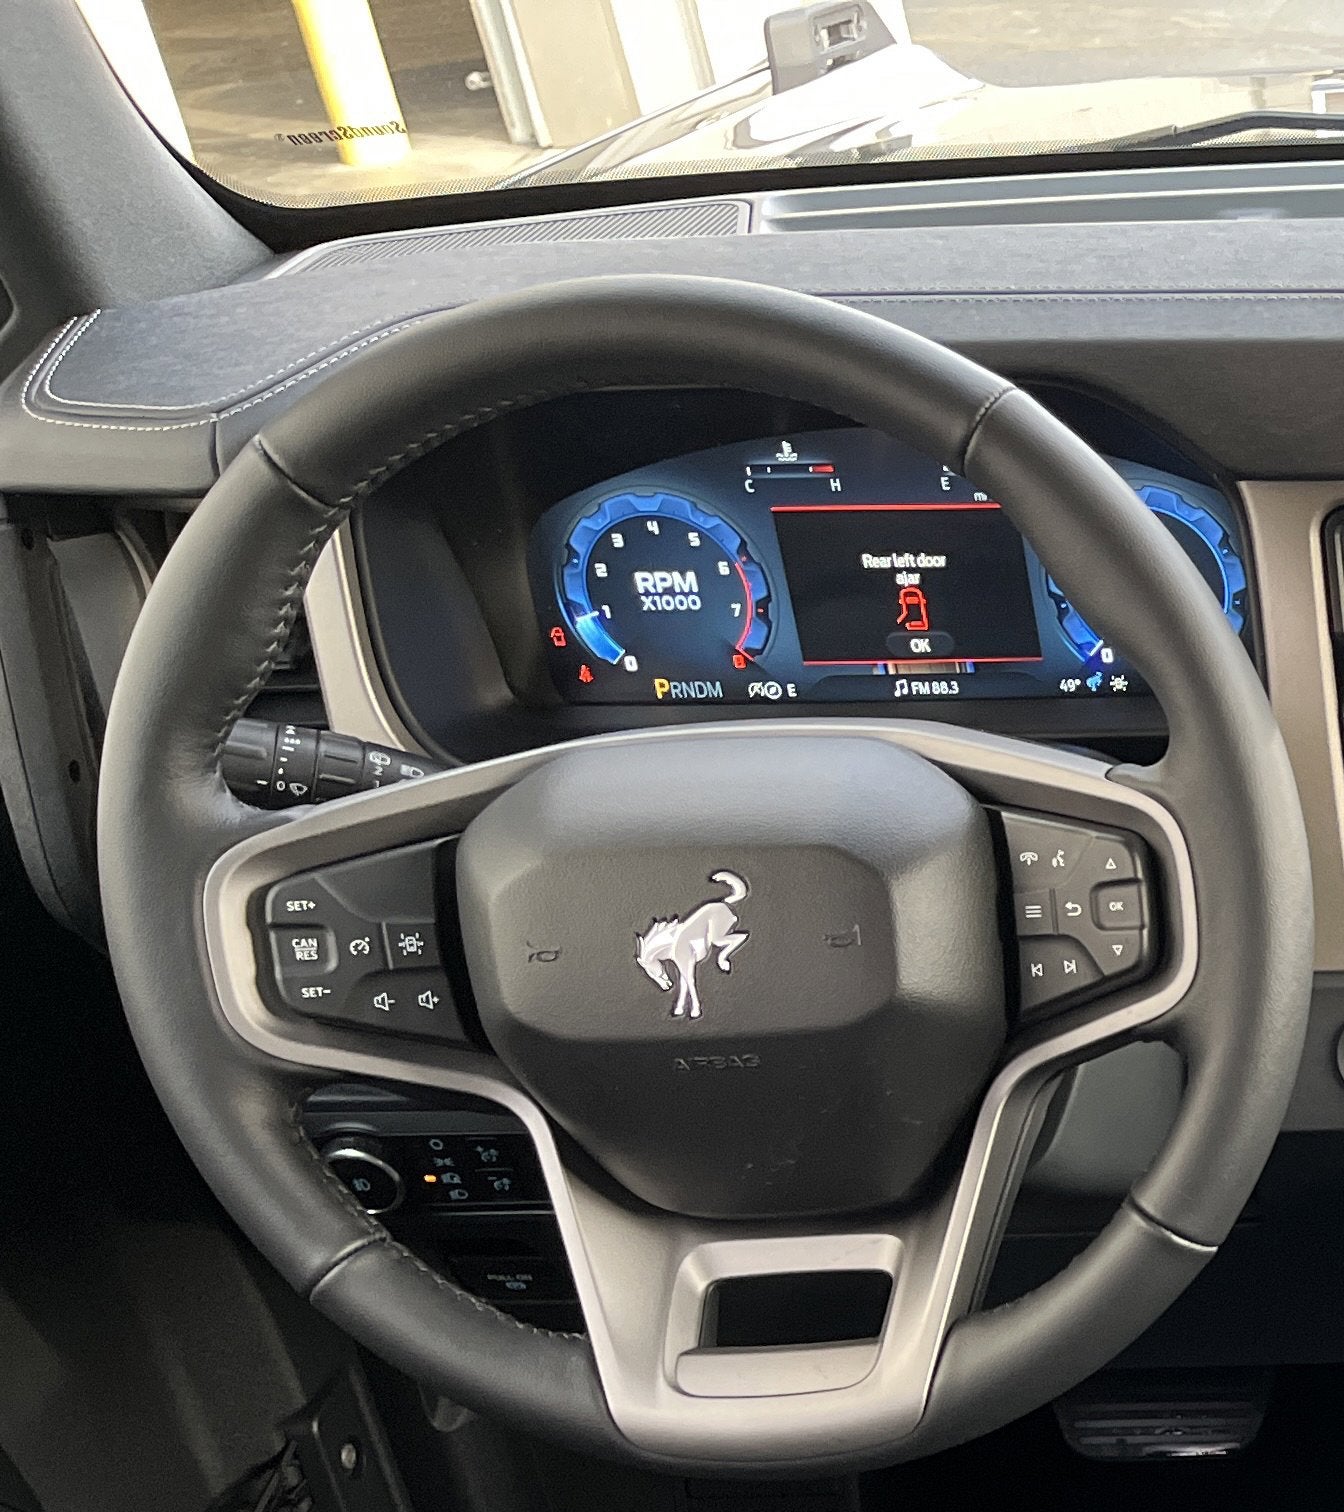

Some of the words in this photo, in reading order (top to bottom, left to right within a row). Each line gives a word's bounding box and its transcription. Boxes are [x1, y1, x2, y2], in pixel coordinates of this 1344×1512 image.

[745, 480, 755, 493] C
[830, 478, 841, 492] H
[940, 477, 950, 490] E
[647, 521, 659, 535] 4
[611, 533, 624, 547] 3
[688, 532, 701, 546] 5
[862, 553, 892, 568] Rear
[893, 553, 917, 568] left
[917, 553, 946, 567] door
[595, 563, 608, 577] 2
[718, 561, 730, 575] 6
[634, 571, 699, 593] RPM
[896, 571, 920, 586] ajar
[640, 595, 702, 611] X1000
[731, 603, 742, 617] 7
[601, 604, 612, 619] 1
[910, 638, 931, 653] OK
[732, 655, 746, 669] 8
[1101, 648, 1114, 663] 0
[624, 655, 638, 672] 0
[911, 682, 931, 695] FM
[931, 681, 959, 695] 88.3
[286, 900, 316, 911] SET+
[1109, 901, 1124, 912] OK
[292, 938, 317, 949] CAN
[295, 950, 319, 961] RES
